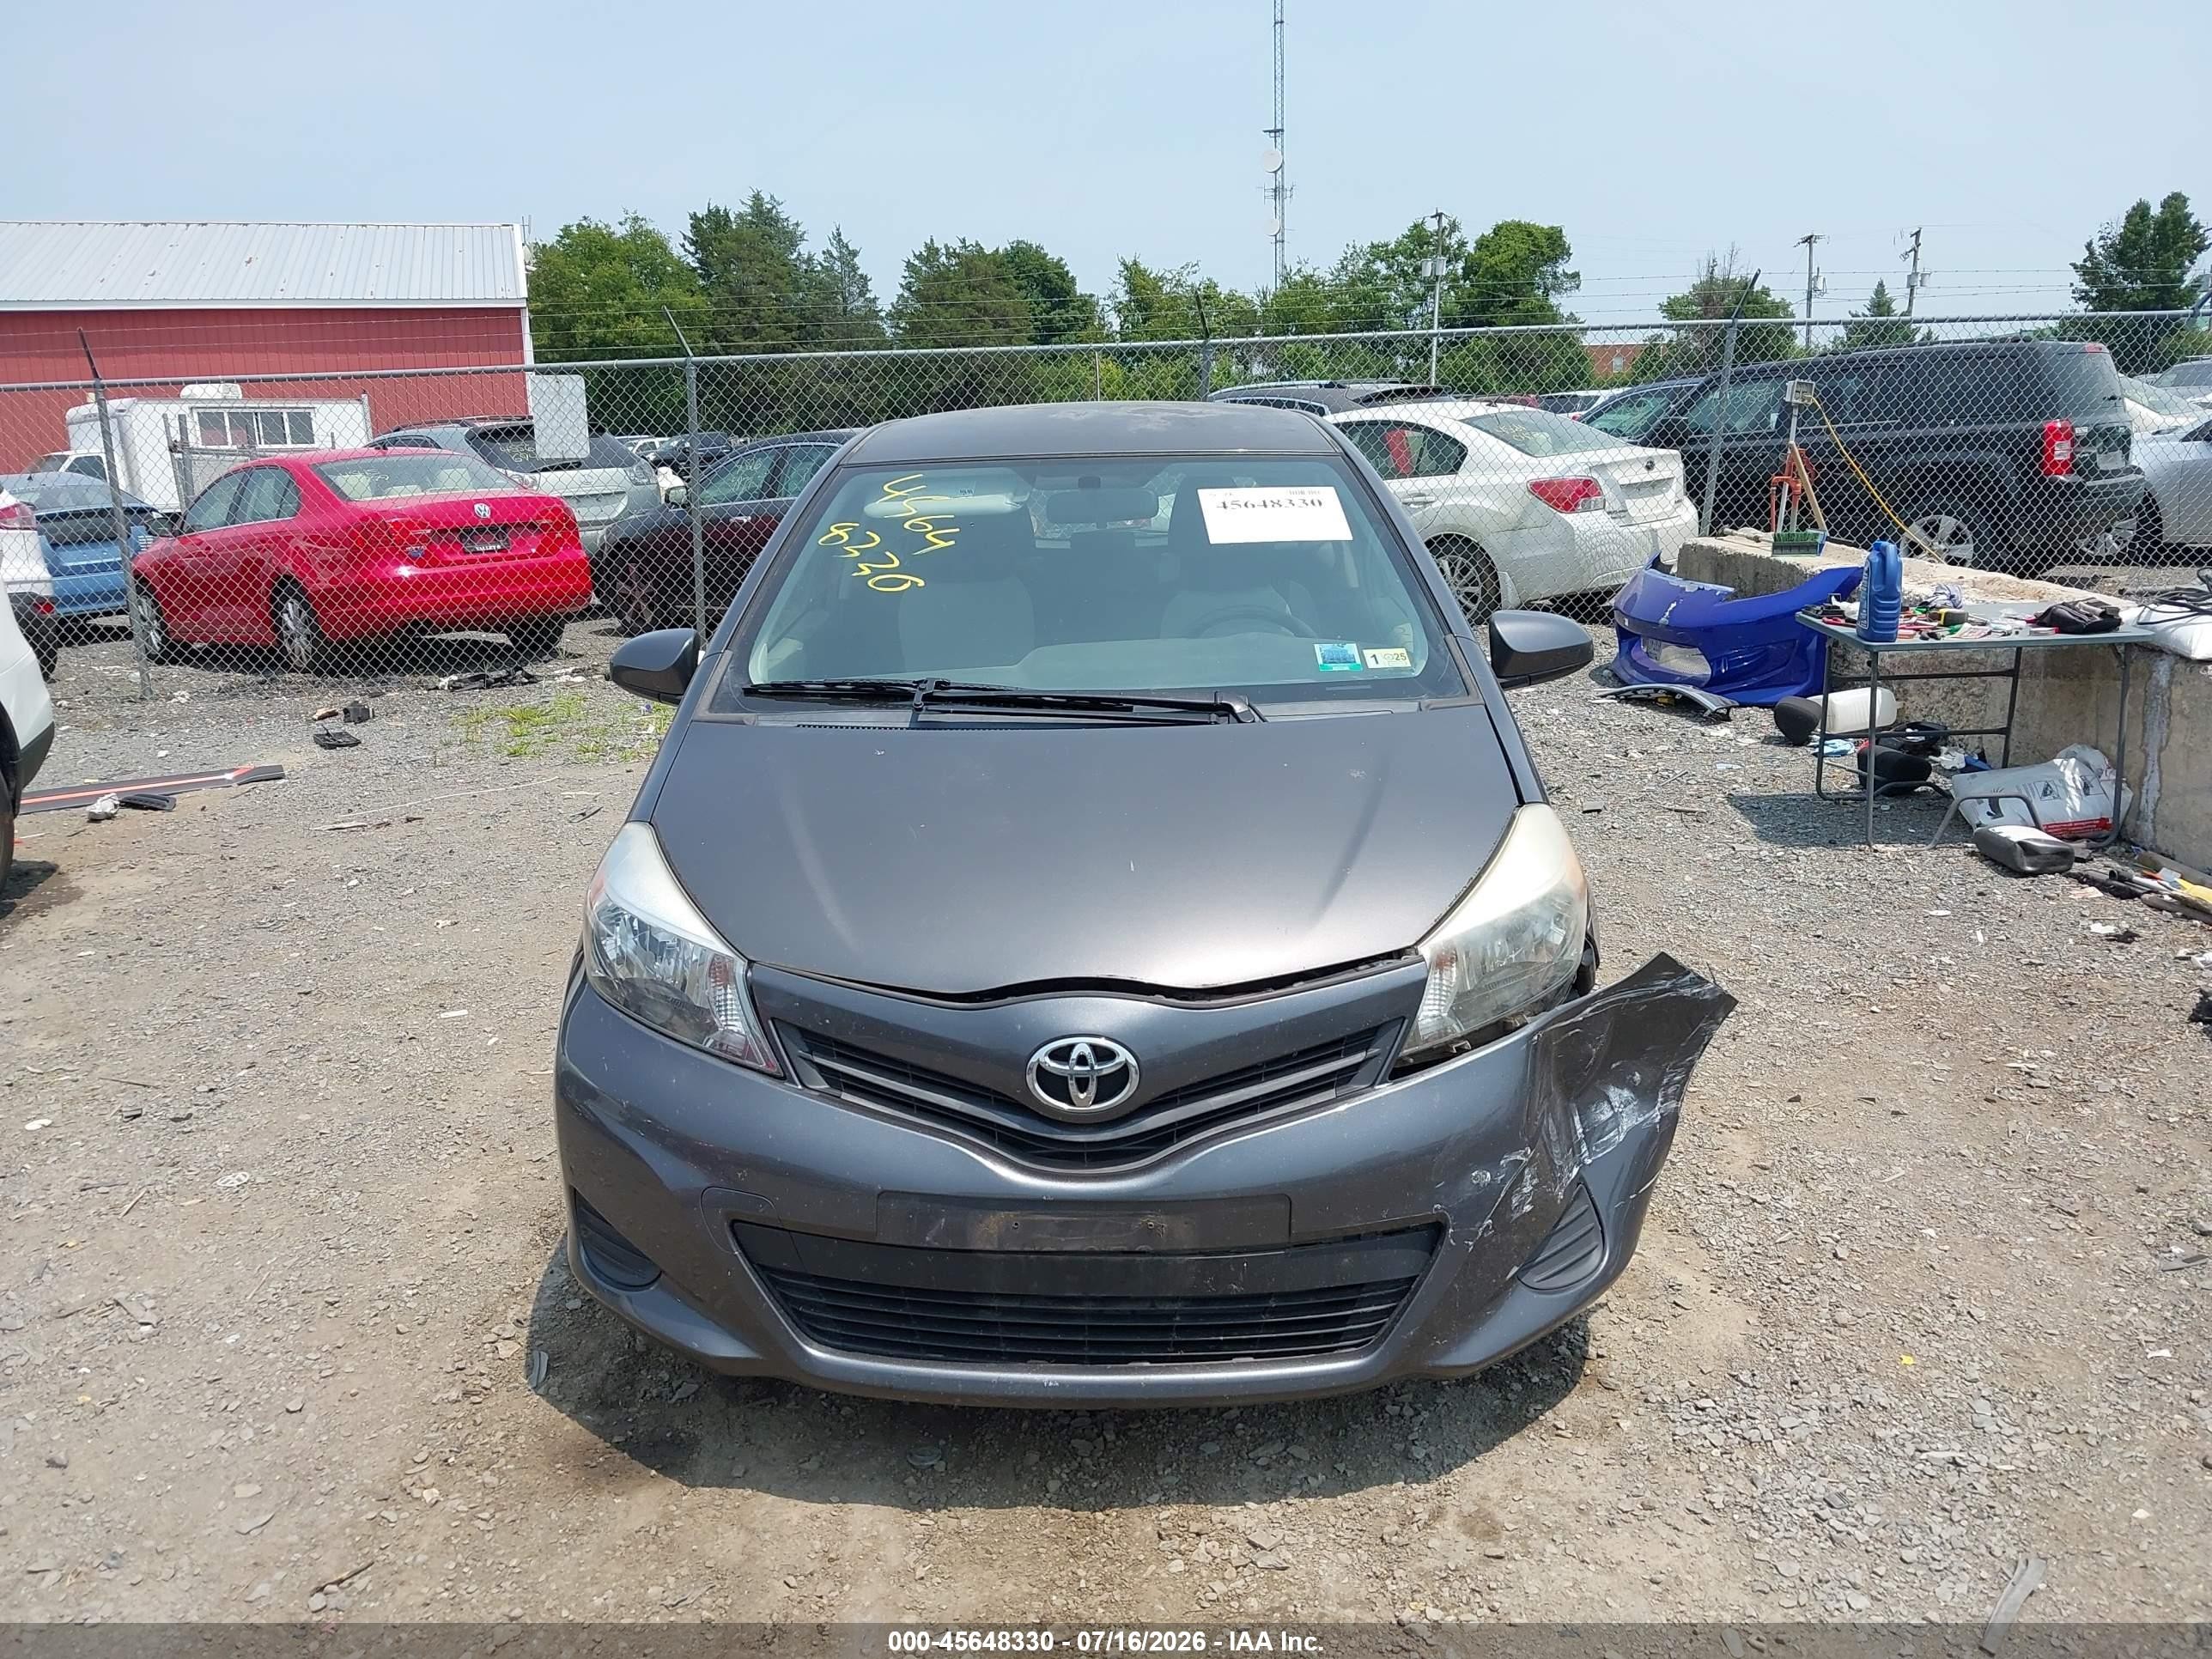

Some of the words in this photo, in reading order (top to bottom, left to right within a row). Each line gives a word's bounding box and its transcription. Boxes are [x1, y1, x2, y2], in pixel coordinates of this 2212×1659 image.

[1216, 498, 1323, 510] 45648330
[876, 473, 961, 556] 4564
[1370, 653, 1379, 665] 1
[1394, 653, 1407, 661] 25
